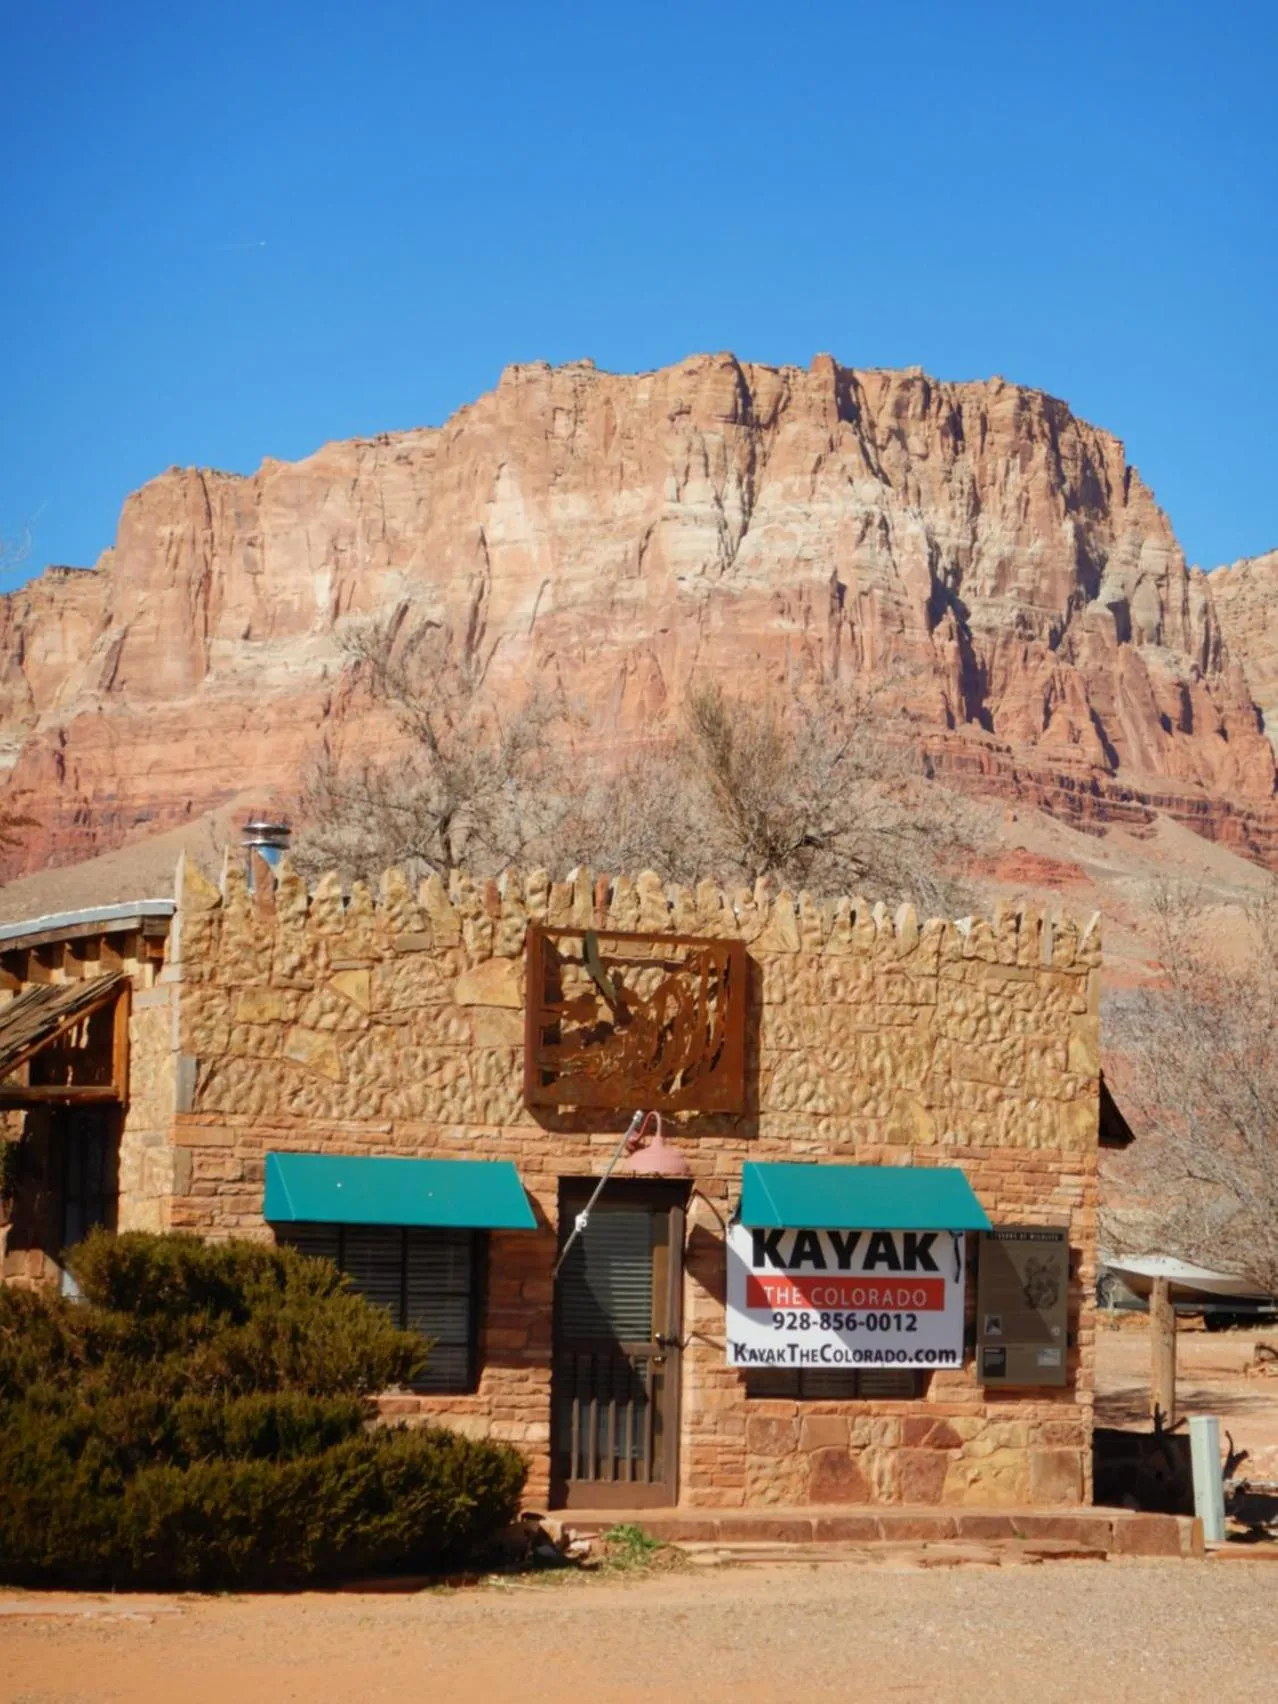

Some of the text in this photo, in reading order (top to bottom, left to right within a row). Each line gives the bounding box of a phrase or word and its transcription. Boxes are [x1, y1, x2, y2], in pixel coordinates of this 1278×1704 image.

[752, 1229, 939, 1272] KAYAK
[763, 1286, 928, 1307] THE COLORADO
[772, 1312, 917, 1332] 928-856-0012
